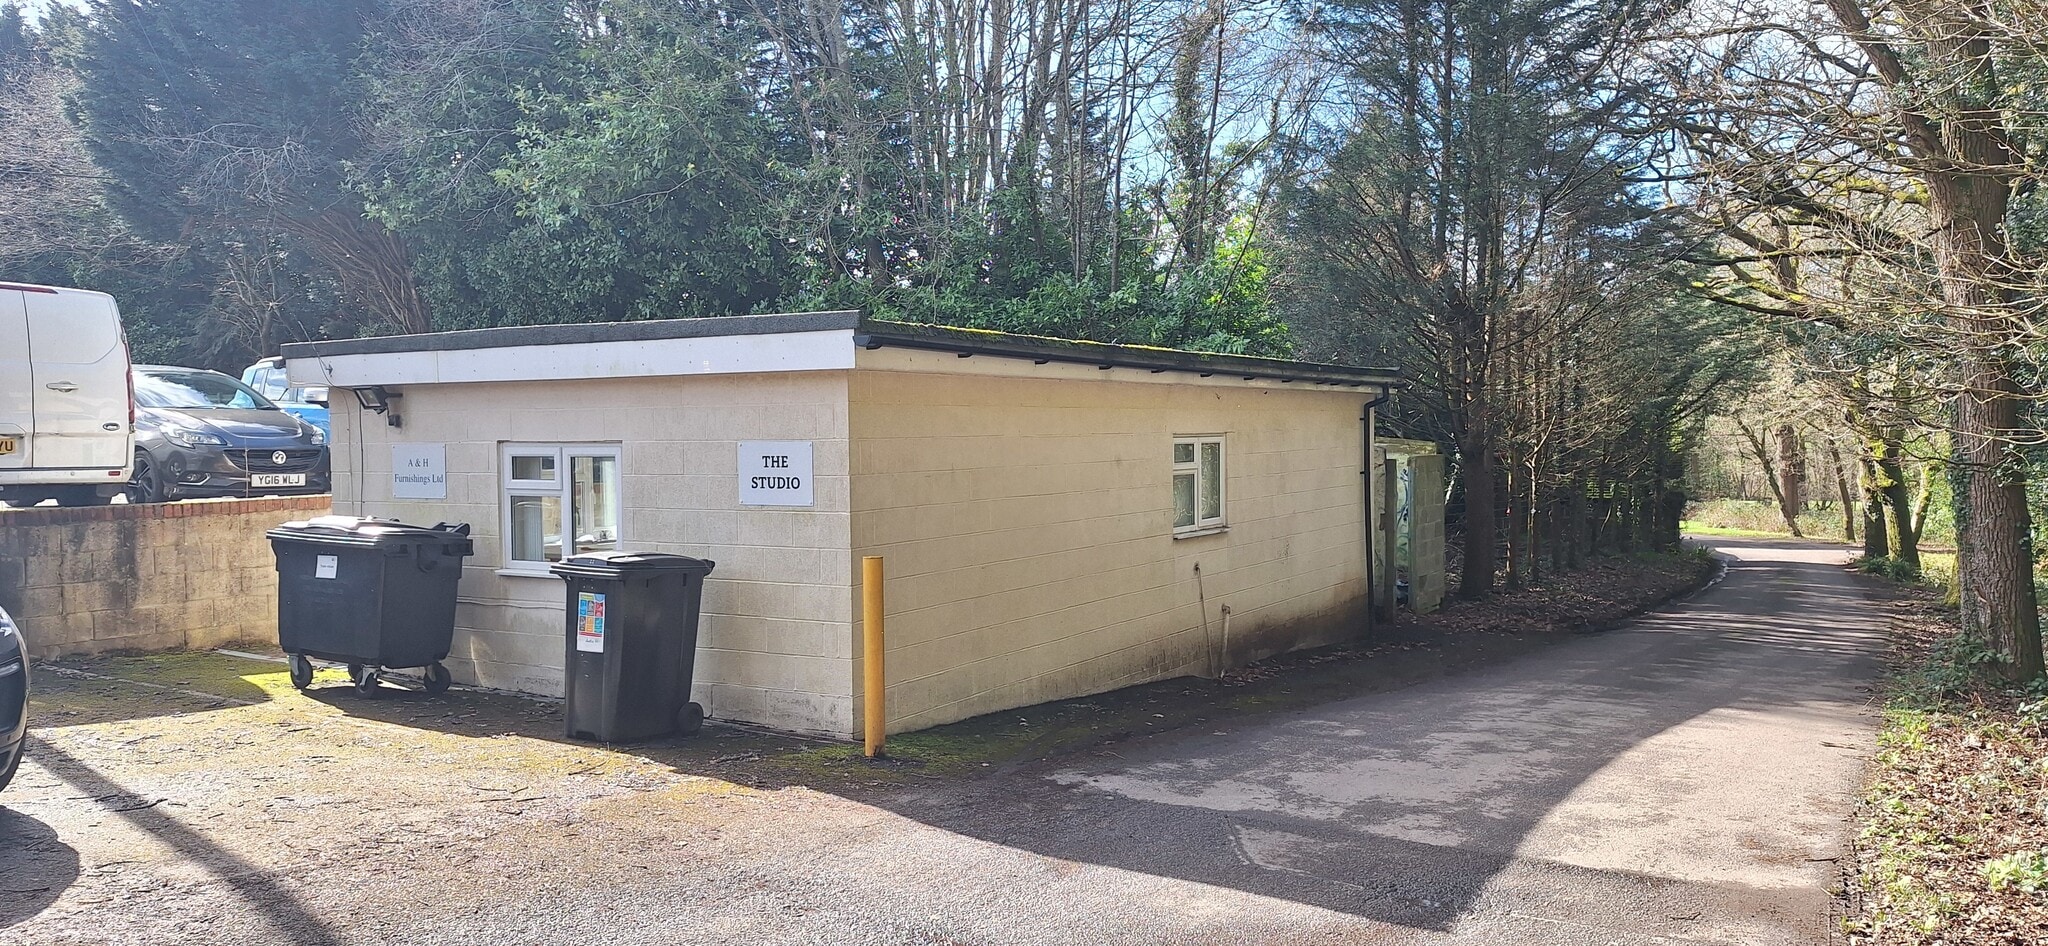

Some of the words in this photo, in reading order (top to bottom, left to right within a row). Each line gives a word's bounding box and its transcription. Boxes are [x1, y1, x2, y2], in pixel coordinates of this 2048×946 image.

[407, 458, 414, 467] A
[414, 458, 421, 467] &
[422, 458, 429, 467] H
[762, 455, 789, 468] THE
[258, 475, 280, 485] YG16
[282, 475, 300, 484] WLJ
[394, 473, 431, 485] Furnishings
[432, 474, 444, 483] Ltd
[751, 476, 801, 490] STUDIO
